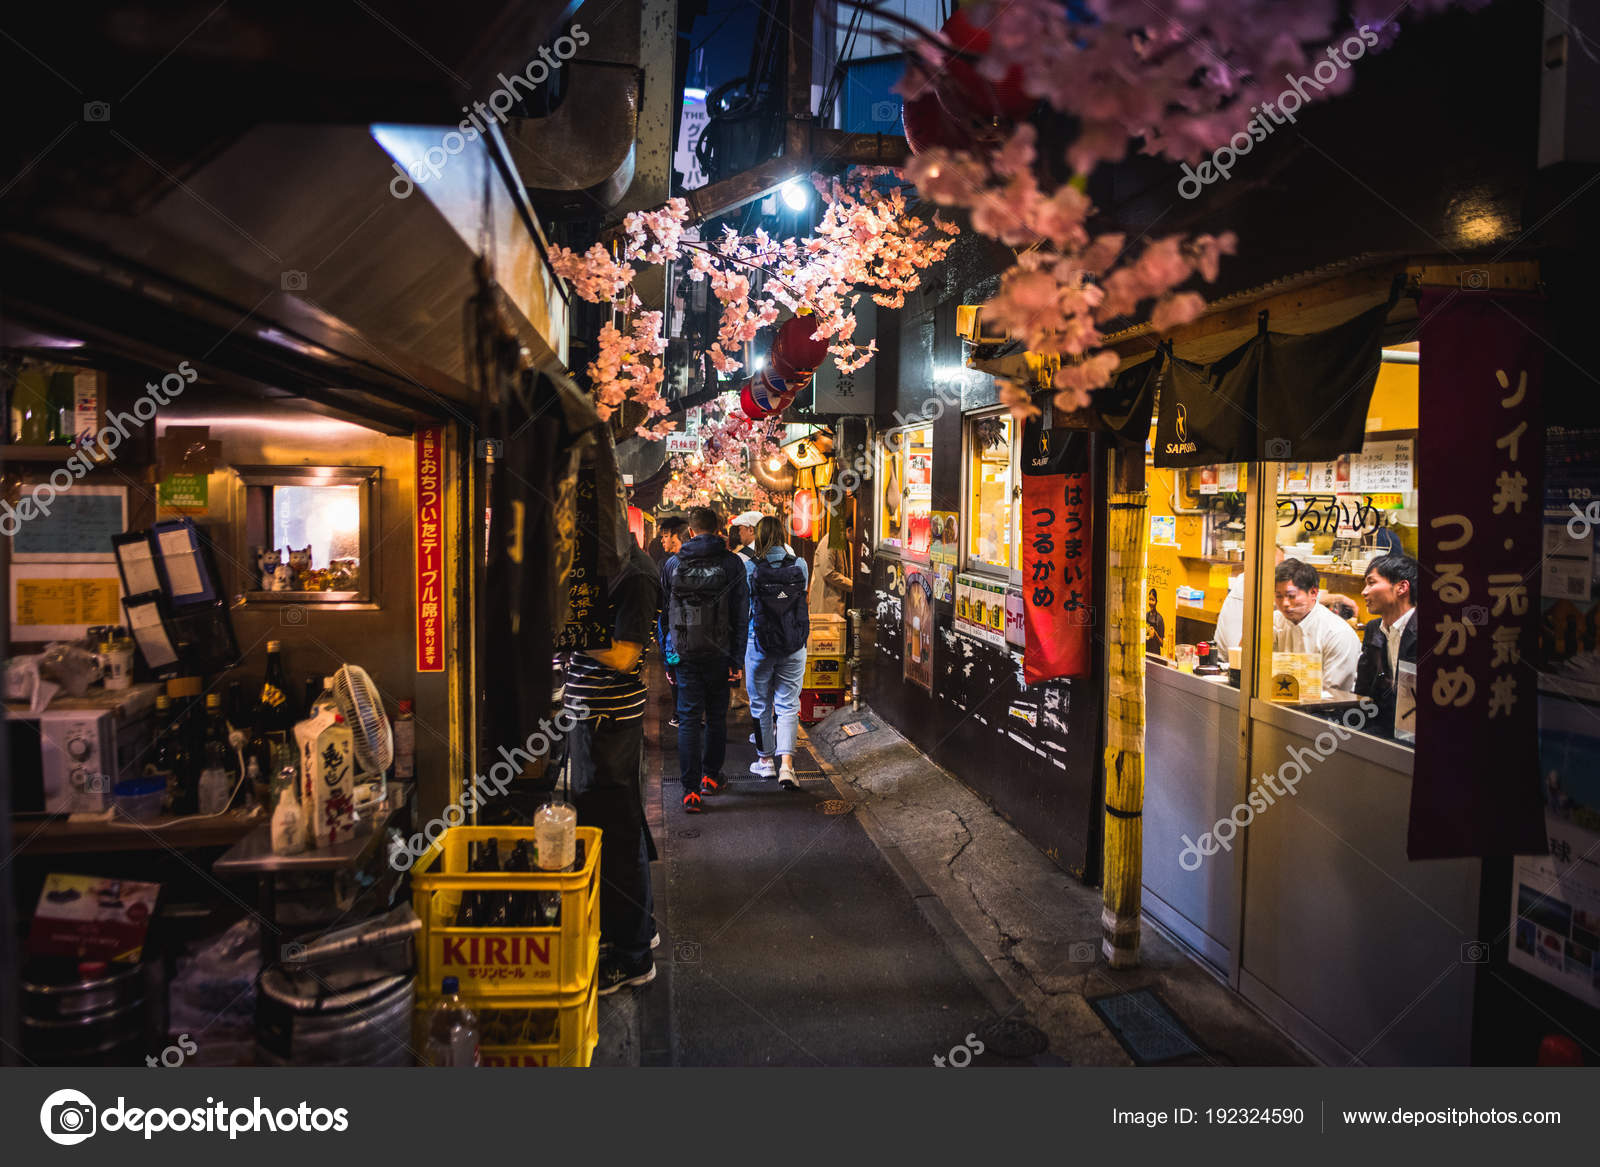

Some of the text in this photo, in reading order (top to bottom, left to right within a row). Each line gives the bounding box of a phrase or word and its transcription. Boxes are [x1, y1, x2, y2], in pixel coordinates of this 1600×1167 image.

[684, 111, 705, 120] THE
[687, 123, 701, 190] グローバ
[1276, 496, 1381, 536] つるかめ
[1031, 507, 1056, 608] つるかめ
[1487, 368, 1529, 720] ソイ丼・元気丼
[1430, 512, 1478, 709] つるかめ
[442, 937, 551, 966] KIRIN
[468, 967, 526, 980] キリンビール
